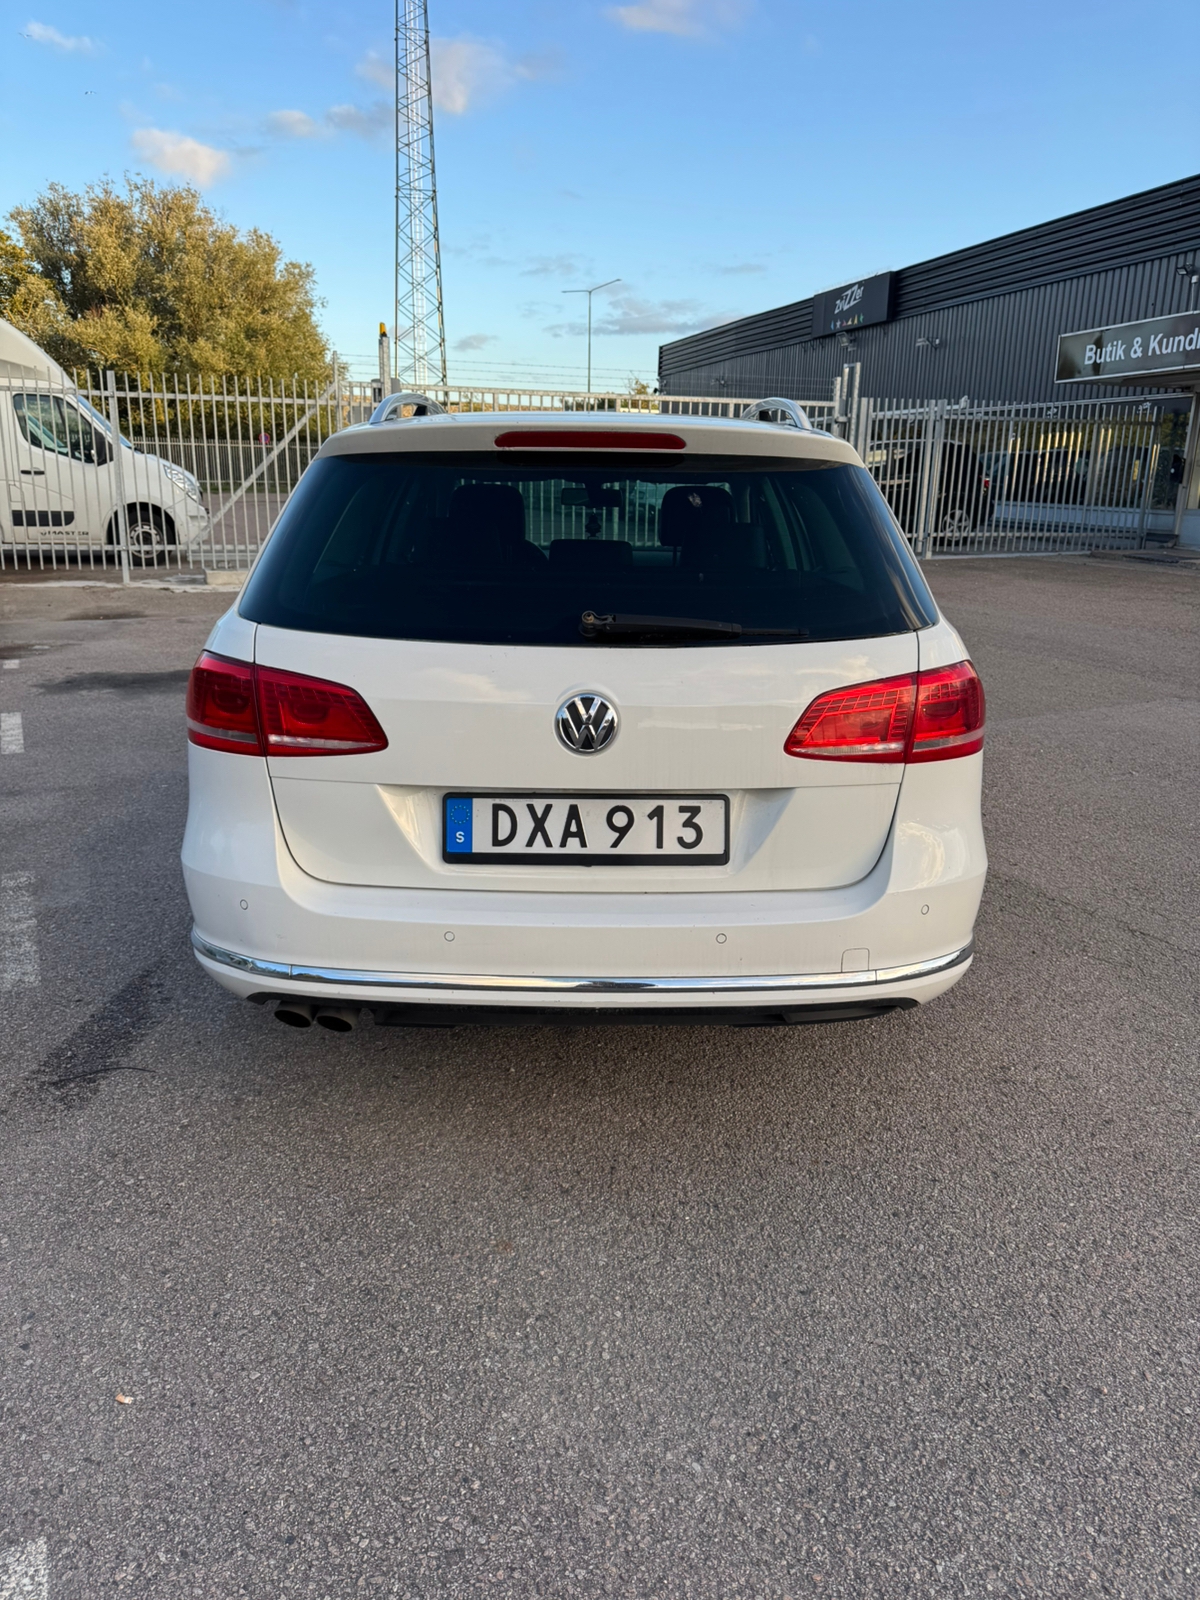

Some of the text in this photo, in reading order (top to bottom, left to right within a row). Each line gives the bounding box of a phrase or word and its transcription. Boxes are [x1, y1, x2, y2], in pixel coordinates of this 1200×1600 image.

[1084, 340, 1126, 365] Butik
[1130, 336, 1143, 359] &
[455, 803, 704, 849] S DXA 913
